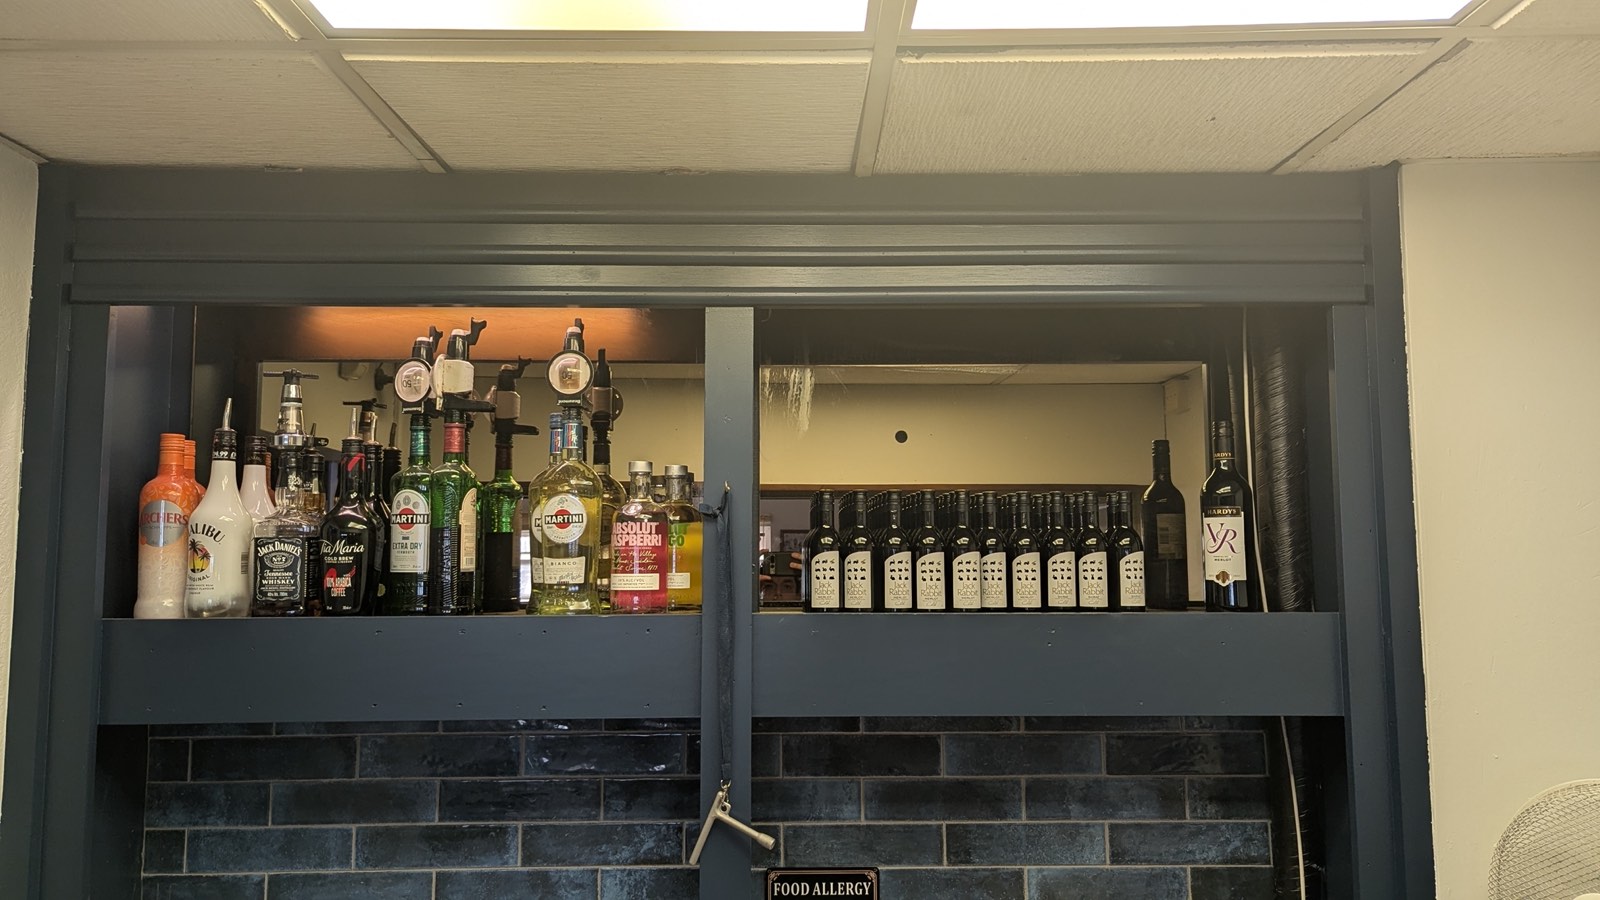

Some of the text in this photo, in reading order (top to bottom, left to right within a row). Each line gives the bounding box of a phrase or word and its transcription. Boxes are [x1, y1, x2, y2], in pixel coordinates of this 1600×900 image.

[391, 513, 428, 525] MARTINI
[544, 514, 583, 525] MARTINI
[612, 521, 660, 534] ABSOLUT
[189, 522, 226, 543] ALIBU
[257, 543, 275, 557] JACK
[329, 539, 365, 556] Maria
[392, 542, 423, 550] EXTRA DRY
[263, 569, 293, 577] Tennessee
[818, 581, 833, 589] Jack
[849, 581, 864, 589] Jack
[894, 581, 907, 589] Jack
[925, 582, 939, 591] Jack
[962, 582, 975, 590] Jack
[1087, 581, 1102, 589] Jack
[814, 588, 836, 596] Rabbit
[847, 588, 867, 596] Rabbit
[889, 588, 910, 596] Rabbit
[957, 588, 978, 596] Rabbit
[982, 588, 1004, 596] Rabbit
[1016, 588, 1038, 596] Rabbit
[1051, 587, 1073, 595] Rabbit
[1082, 587, 1105, 596] Rabbit
[773, 881, 872, 896] FOOD ALLERGY
